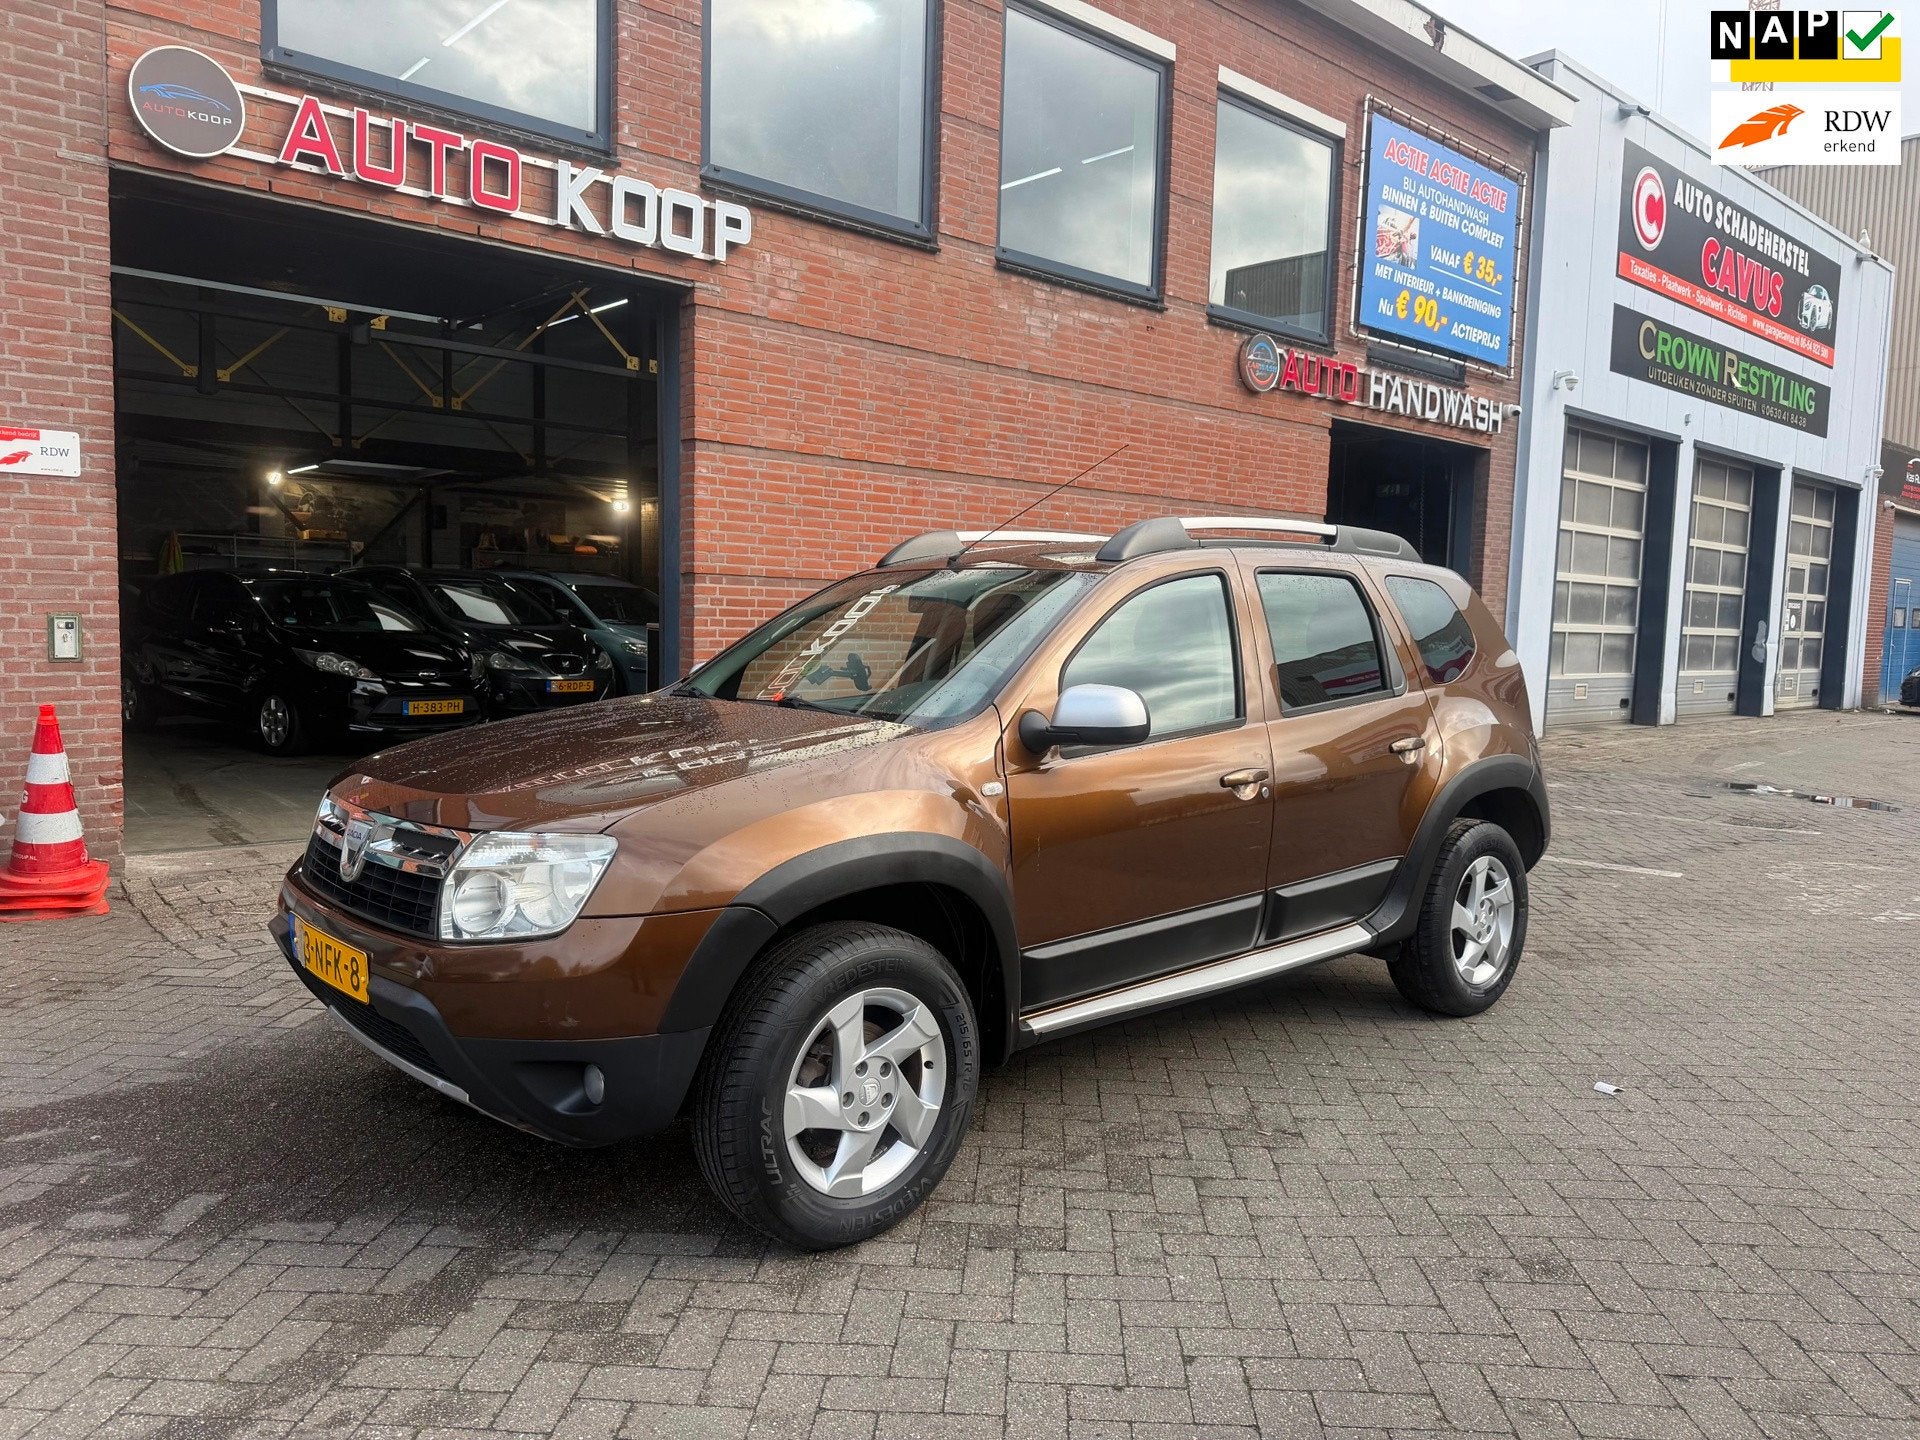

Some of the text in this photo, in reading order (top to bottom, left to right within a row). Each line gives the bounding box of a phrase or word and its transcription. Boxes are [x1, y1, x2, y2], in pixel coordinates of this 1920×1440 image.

[142, 101, 232, 125] AUTOKOOP
[278, 94, 752, 262] AUTO KOOP
[1384, 137, 1508, 214] ACTIE ACTIE ACTIE
[1403, 176, 1489, 226] BIJ AUTOHANDWASH
[1382, 185, 1504, 249] BINNEN & BUITEN COMPLEET
[1673, 178, 1810, 277] AUTO SCHADEHERSTEL
[1430, 245, 1460, 269] VANAF
[1463, 250, 1475, 275] €
[1661, 273, 1692, 299] Plaatwerk
[1702, 237, 1784, 318] CAVUS
[1375, 263, 1393, 280] MET
[1393, 270, 1435, 295] INTERIEUR
[1442, 286, 1502, 319] BANKREINIGING
[1396, 290, 1410, 319] €
[1450, 321, 1501, 350] ACTIEPRIJS
[1281, 349, 1503, 433] AUTO HANDWASH
[1639, 320, 1816, 415] CROWN RESTYLING
[1648, 366, 1695, 393] UITDEUKEN
[1695, 383, 1727, 403] ZONDER
[1728, 392, 1757, 412] SPUITEN
[40, 446, 70, 457] RDW
[412, 701, 460, 713] H-383-PH
[955, 1013, 973, 1057] 215/65
[760, 1096, 783, 1186] ULTRAC
